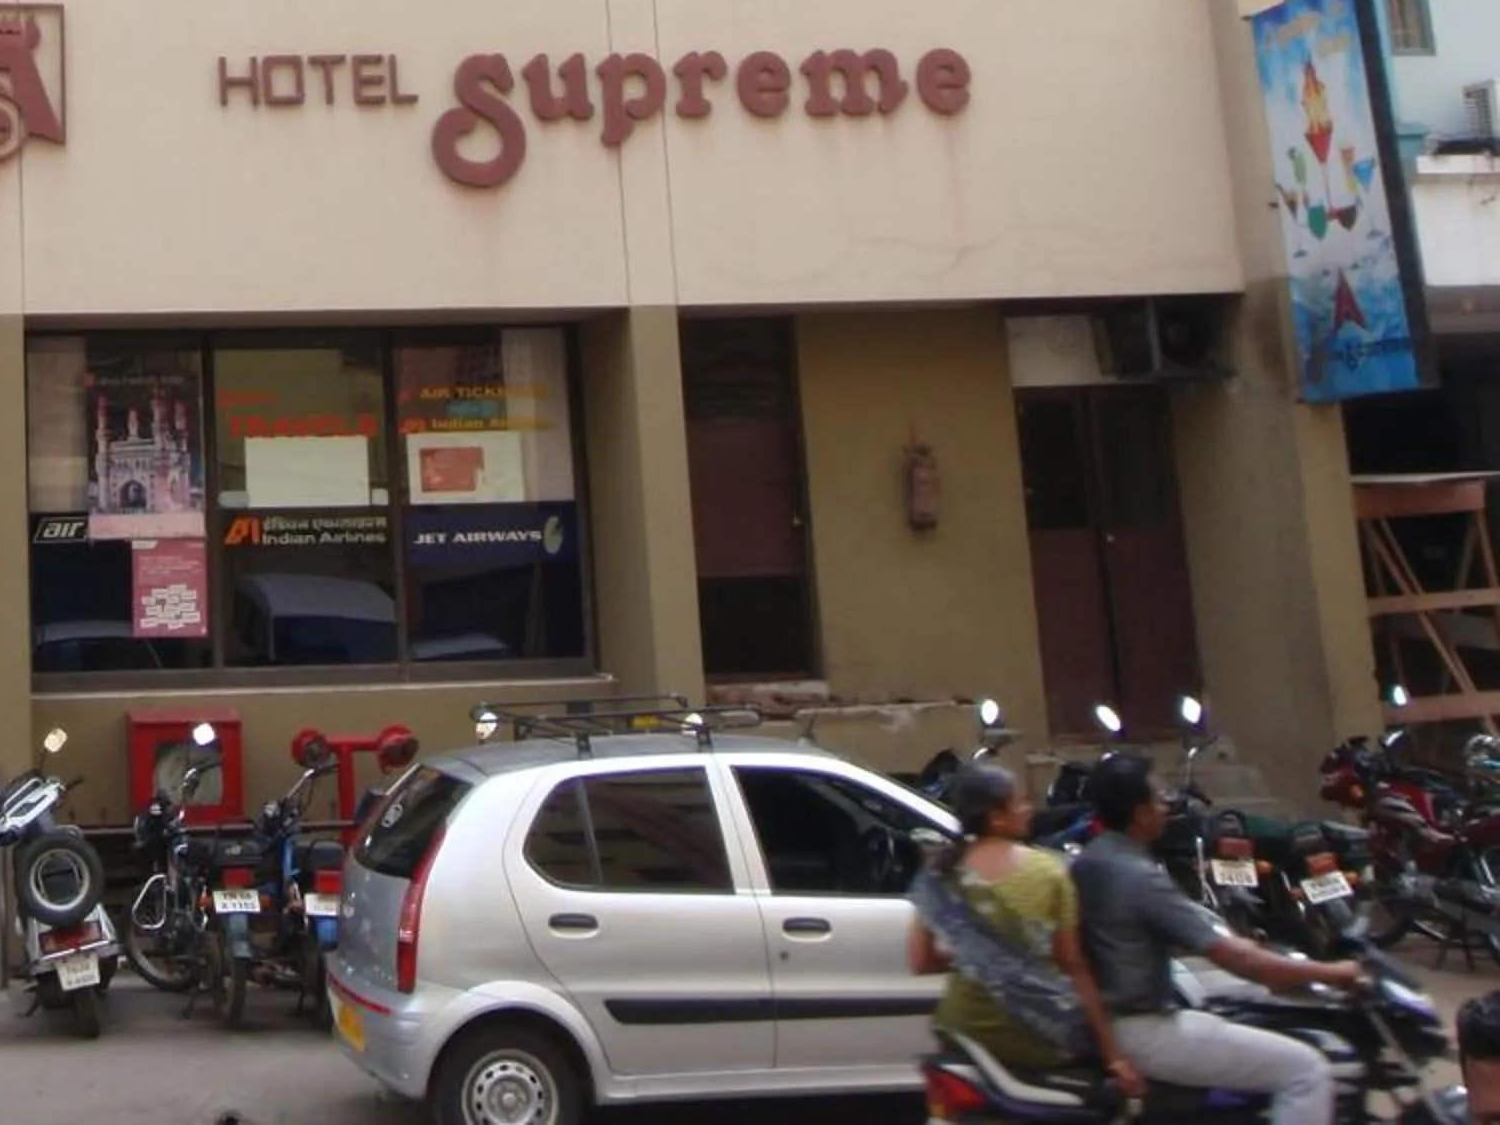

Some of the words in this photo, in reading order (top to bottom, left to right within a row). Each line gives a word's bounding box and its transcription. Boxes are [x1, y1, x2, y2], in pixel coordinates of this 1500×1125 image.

[217, 53, 419, 107] HOTEL
[431, 46, 972, 188] Supreme
[263, 531, 316, 545] Indian
[319, 530, 387, 544] Airlines
[414, 532, 447, 544] JET
[452, 530, 542, 543] AIRWAYS
